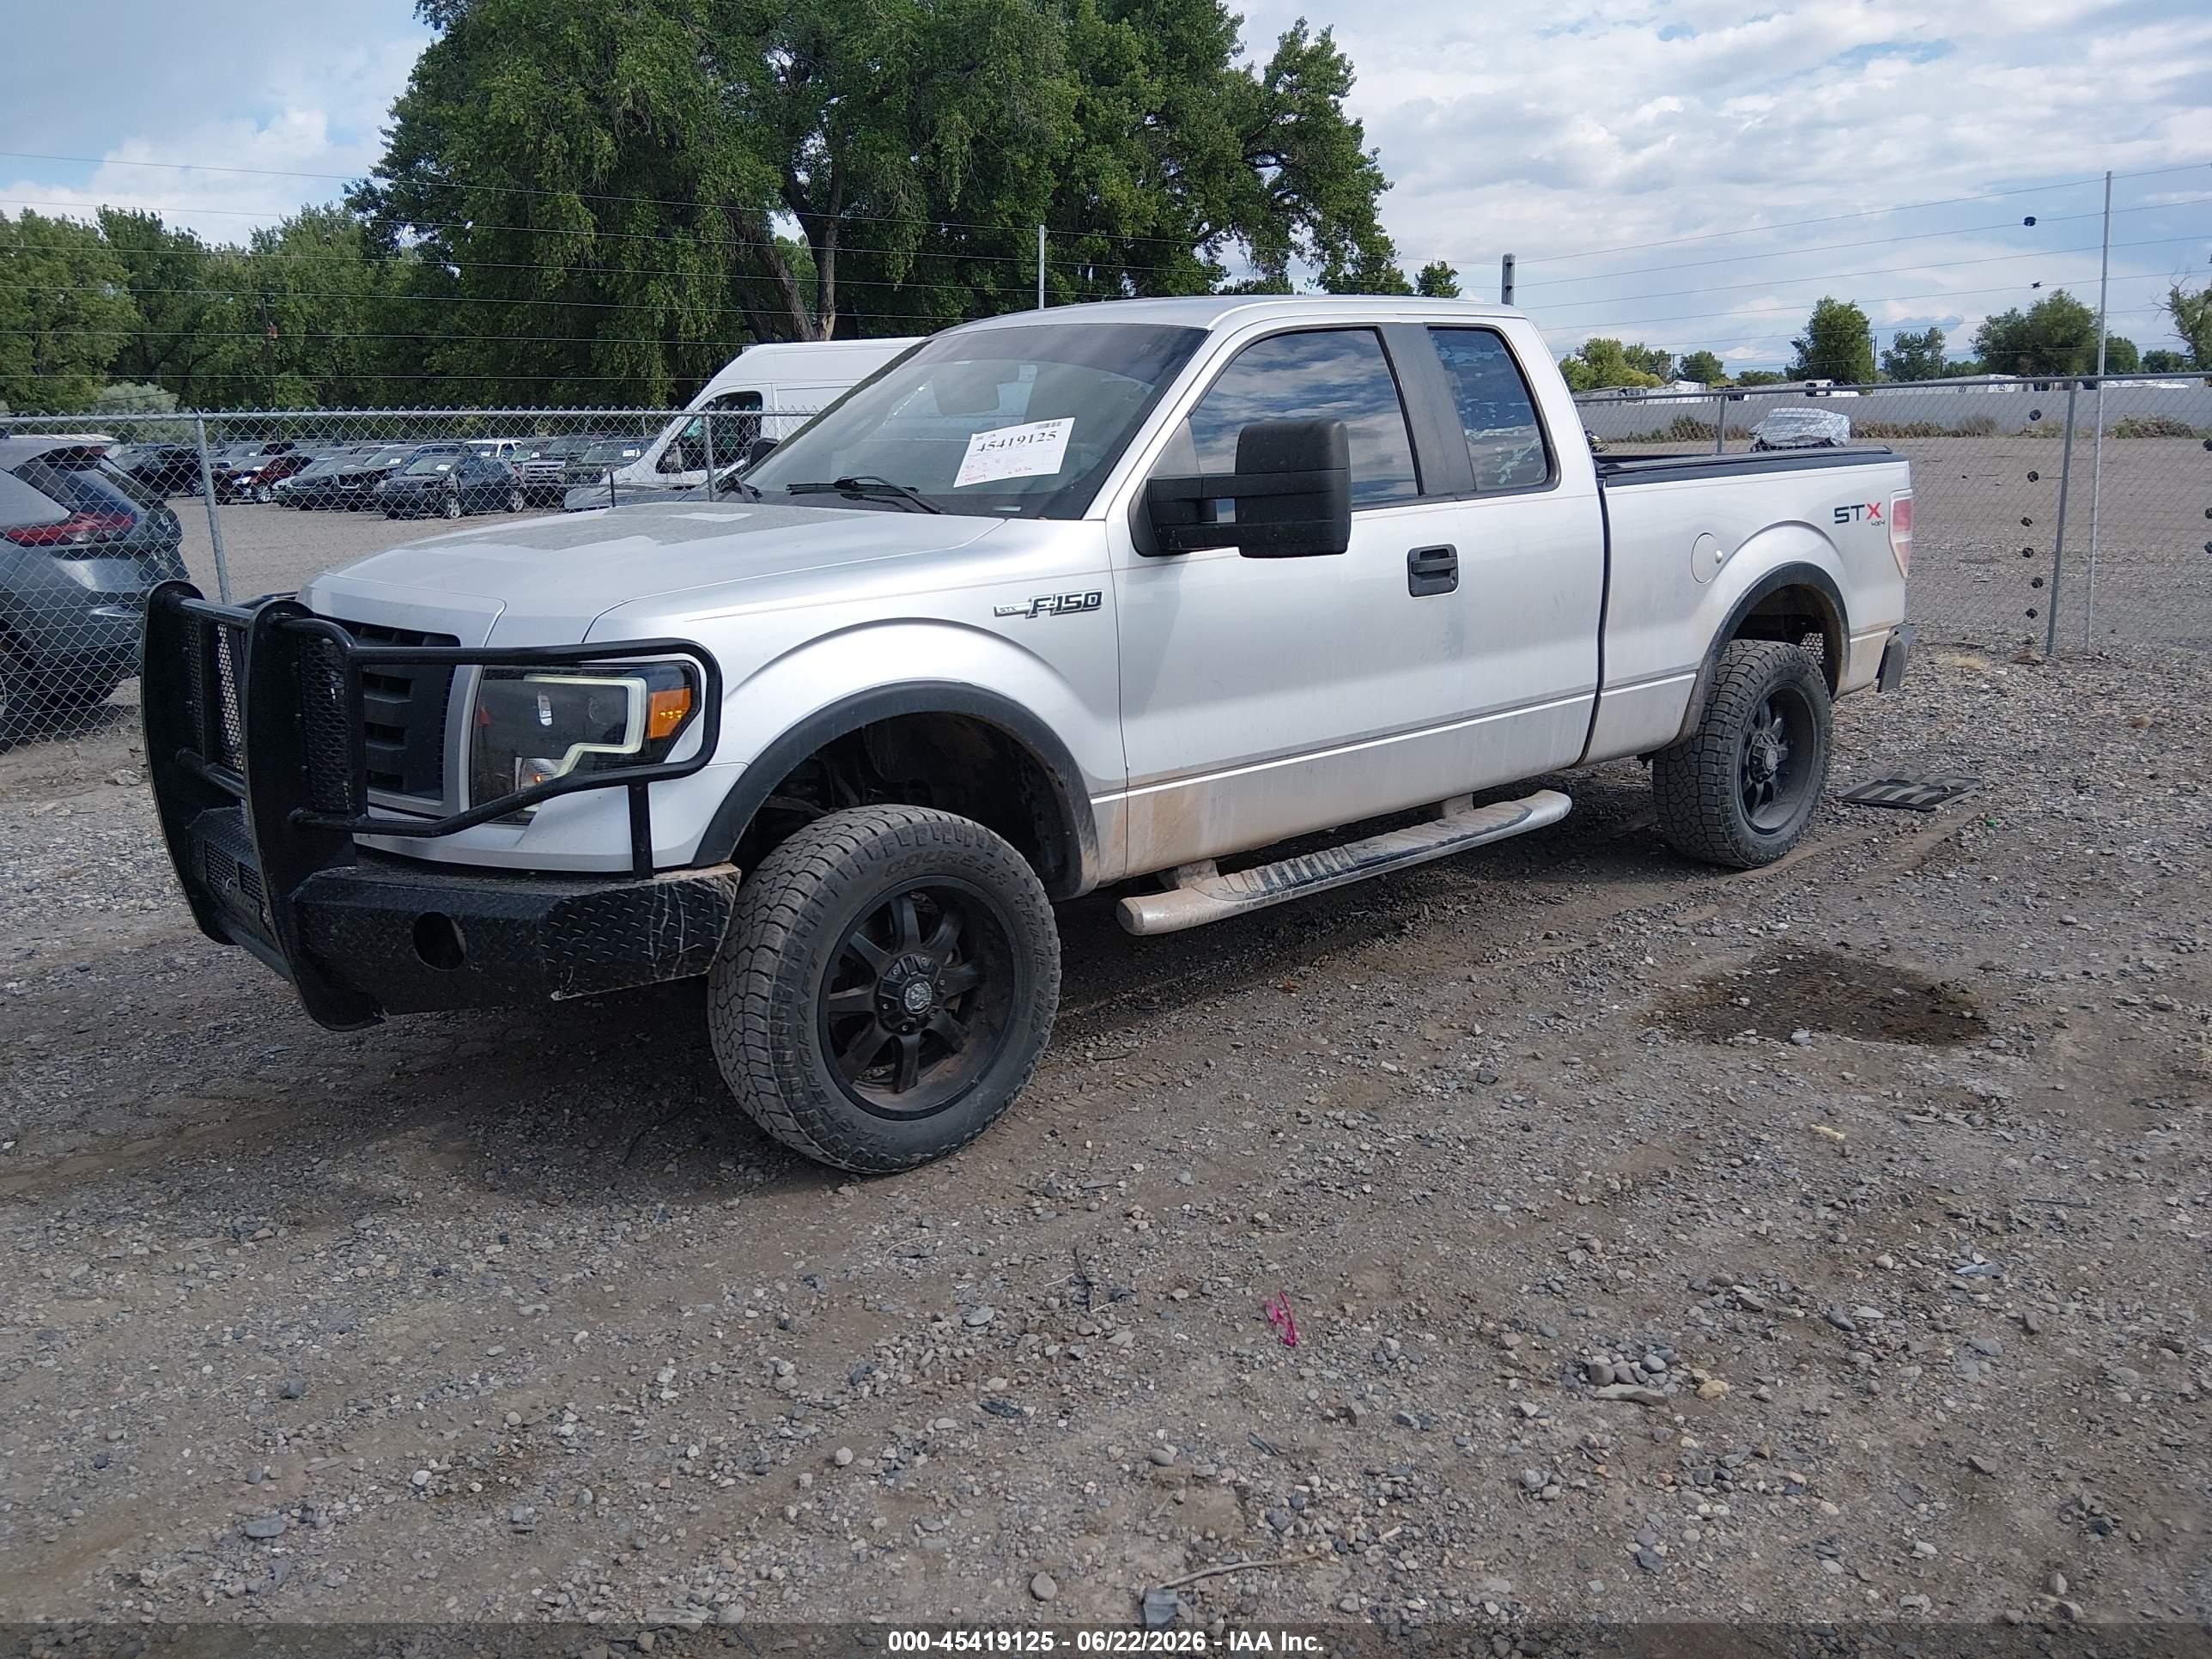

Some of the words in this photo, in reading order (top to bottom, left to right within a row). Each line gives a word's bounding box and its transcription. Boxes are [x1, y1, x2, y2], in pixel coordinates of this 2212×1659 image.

[976, 431, 1057, 453] 45419125
[1833, 501, 1881, 525] STX
[999, 605, 1018, 613] STX
[1029, 590, 1103, 617] F-150
